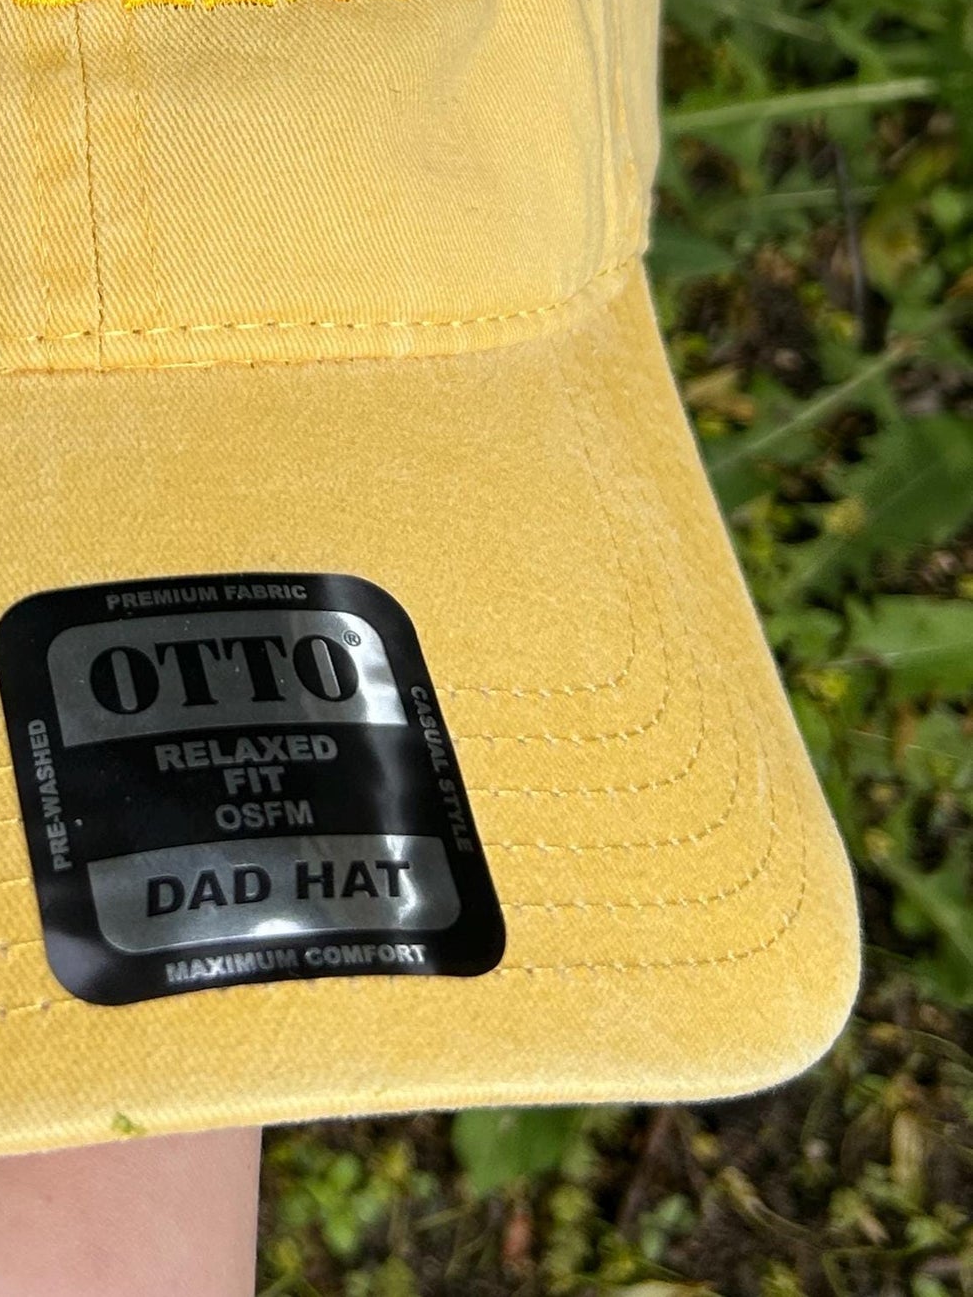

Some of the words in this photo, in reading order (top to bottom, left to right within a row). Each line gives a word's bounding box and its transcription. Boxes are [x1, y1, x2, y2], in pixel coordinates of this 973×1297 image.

[106, 584, 218, 610] PREMIUM
[226, 583, 308, 601] FABRIC
[155, 734, 338, 771] RELAXED
[410, 684, 453, 772] CASUAL
[439, 779, 474, 854] STYLE
[27, 718, 71, 872] PRE-WASHED
[223, 766, 286, 794] FIT
[215, 800, 314, 831] OSFM
[146, 867, 272, 917] DAD
[295, 859, 410, 901] HAT
[165, 946, 299, 983] MAXIMUM
[304, 942, 427, 967] COMFORT
